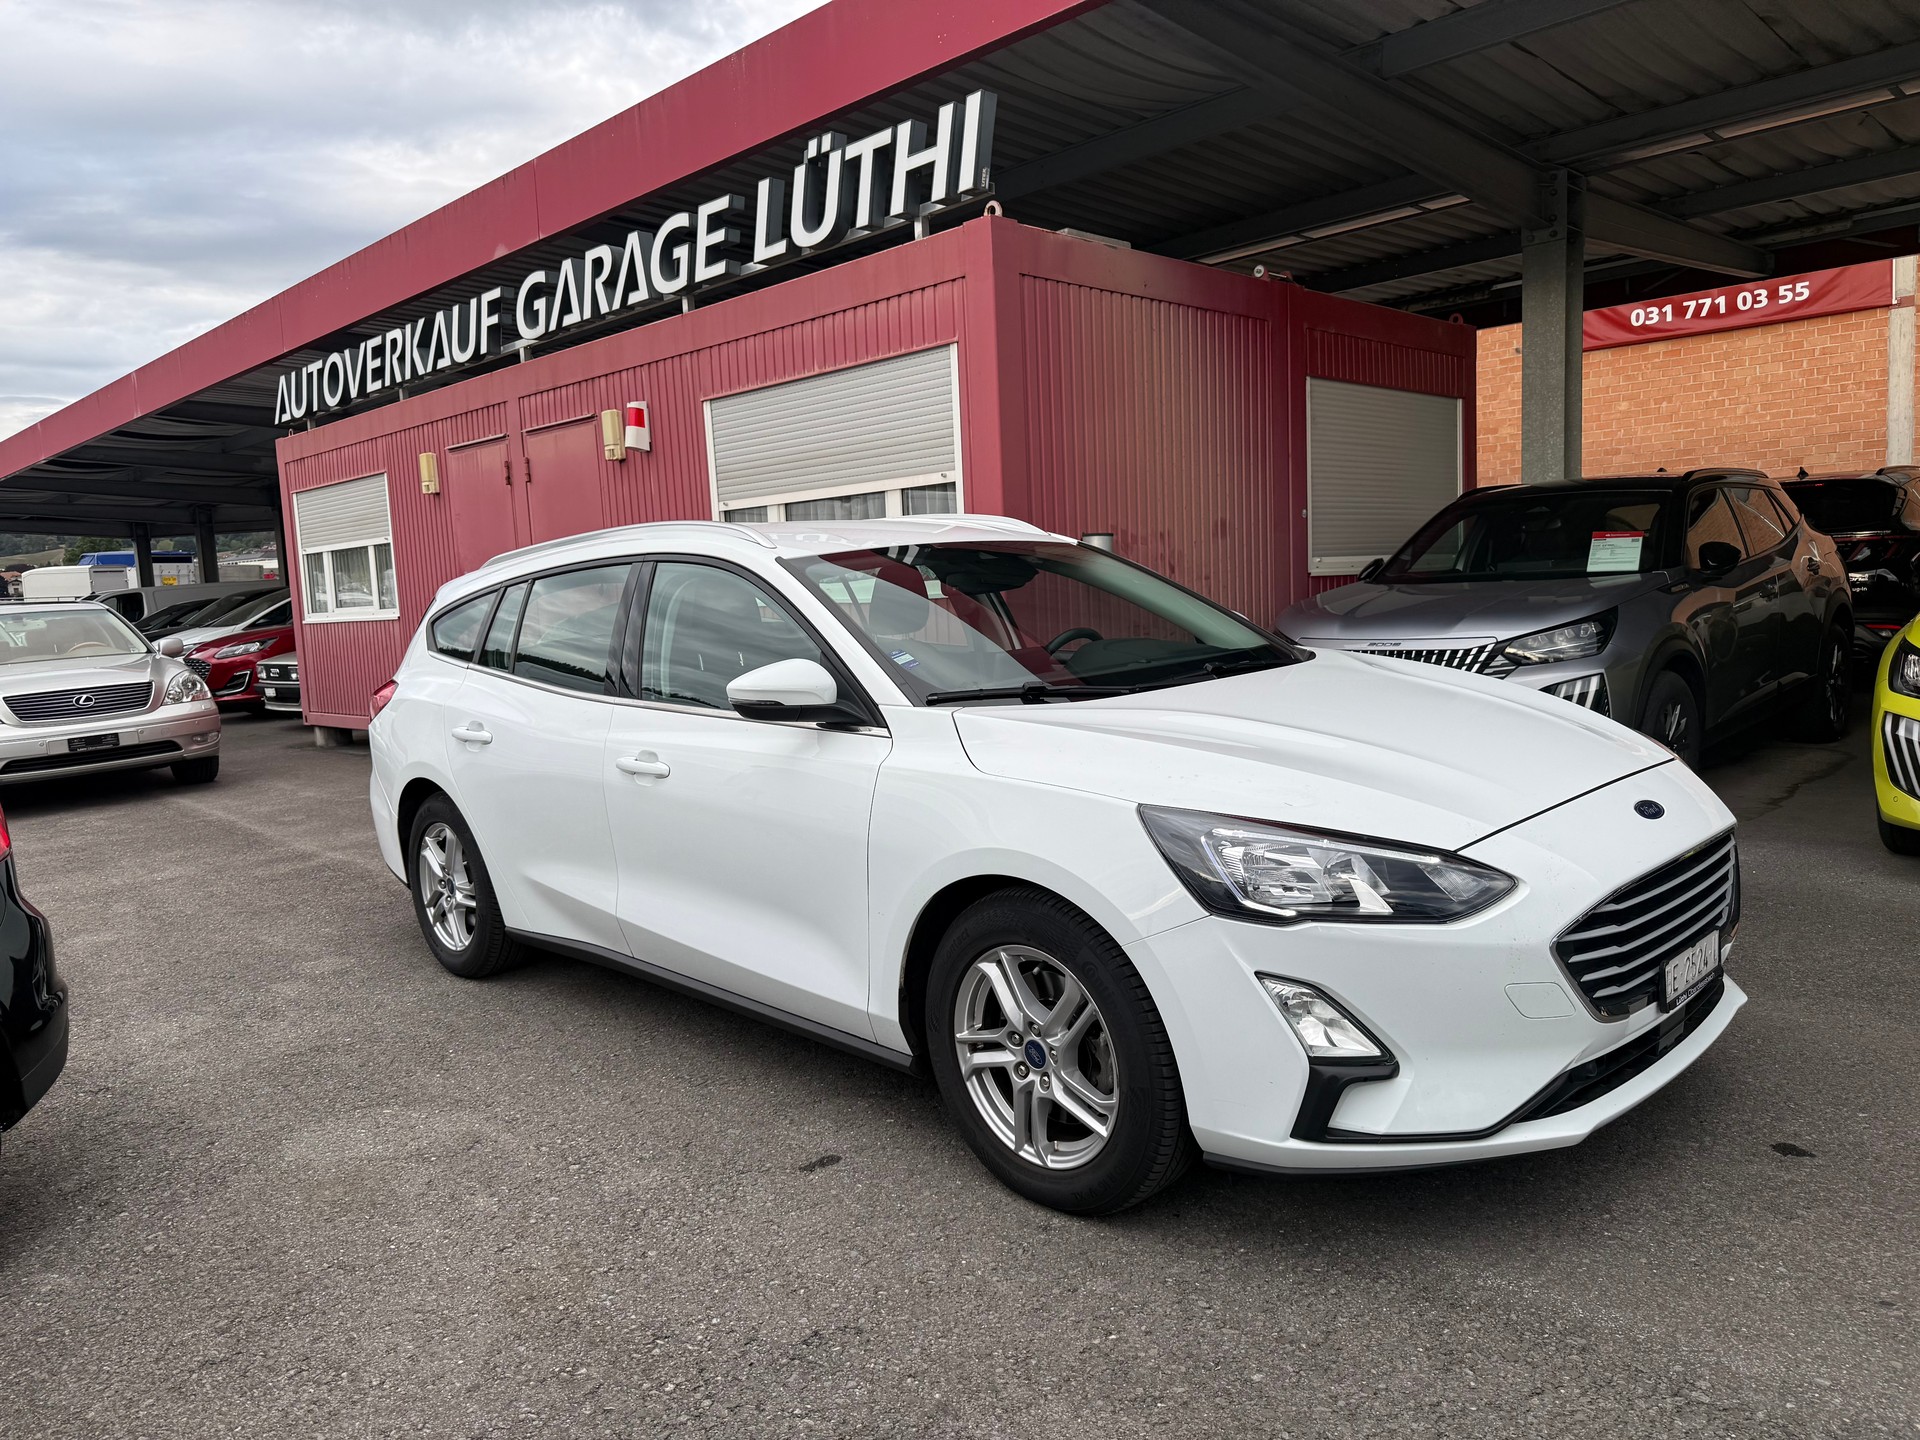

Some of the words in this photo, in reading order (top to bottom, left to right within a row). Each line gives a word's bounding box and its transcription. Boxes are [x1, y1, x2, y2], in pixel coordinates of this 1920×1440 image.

[274, 286, 502, 425] AUTOVERKAUF
[516, 194, 735, 339] GARAGE
[753, 88, 988, 265] LÜTHI
[1630, 304, 1672, 327] 031
[1682, 295, 1726, 320] 771
[1736, 288, 1769, 311] 03
[1778, 281, 1810, 304] 55
